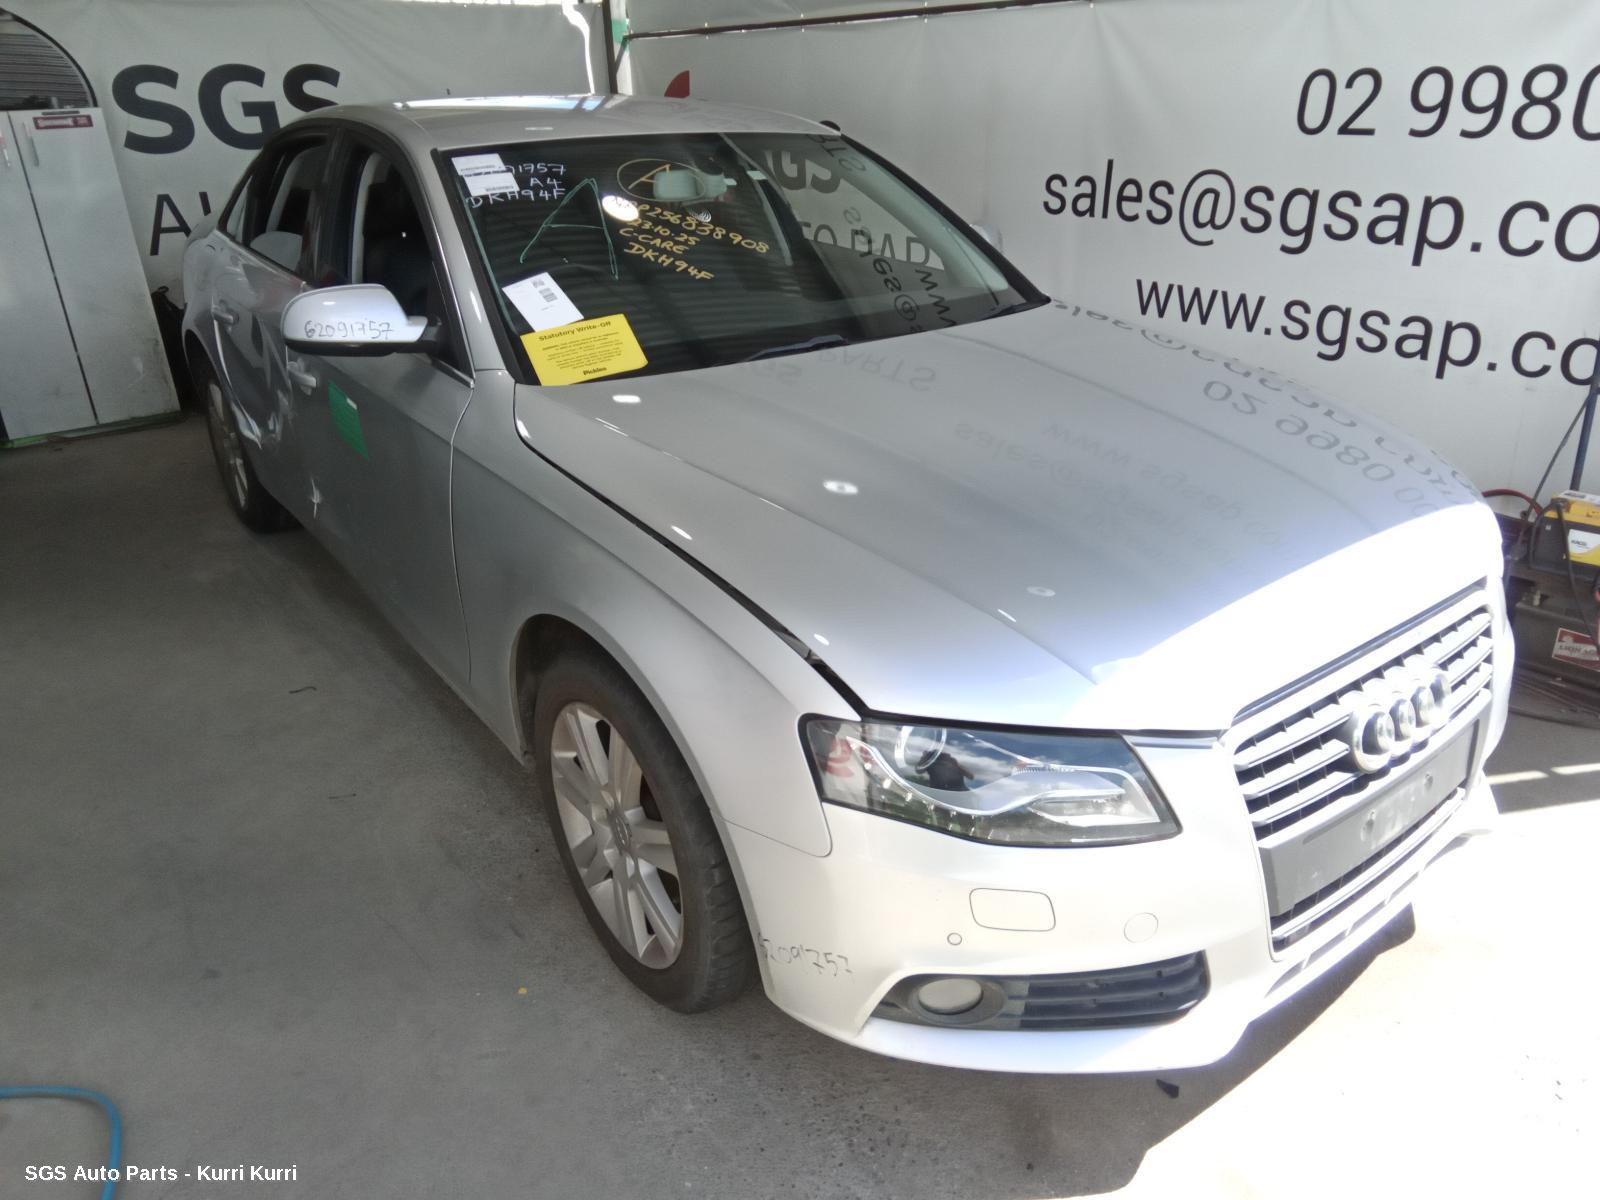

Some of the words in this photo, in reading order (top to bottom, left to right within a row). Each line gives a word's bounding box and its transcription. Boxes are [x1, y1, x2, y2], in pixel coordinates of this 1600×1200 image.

[1296, 67, 1383, 137] 02
[1042, 159, 1600, 267] sales@sgsap.co
[303, 320, 394, 341] 62091757
[538, 328, 576, 342] Statutory
